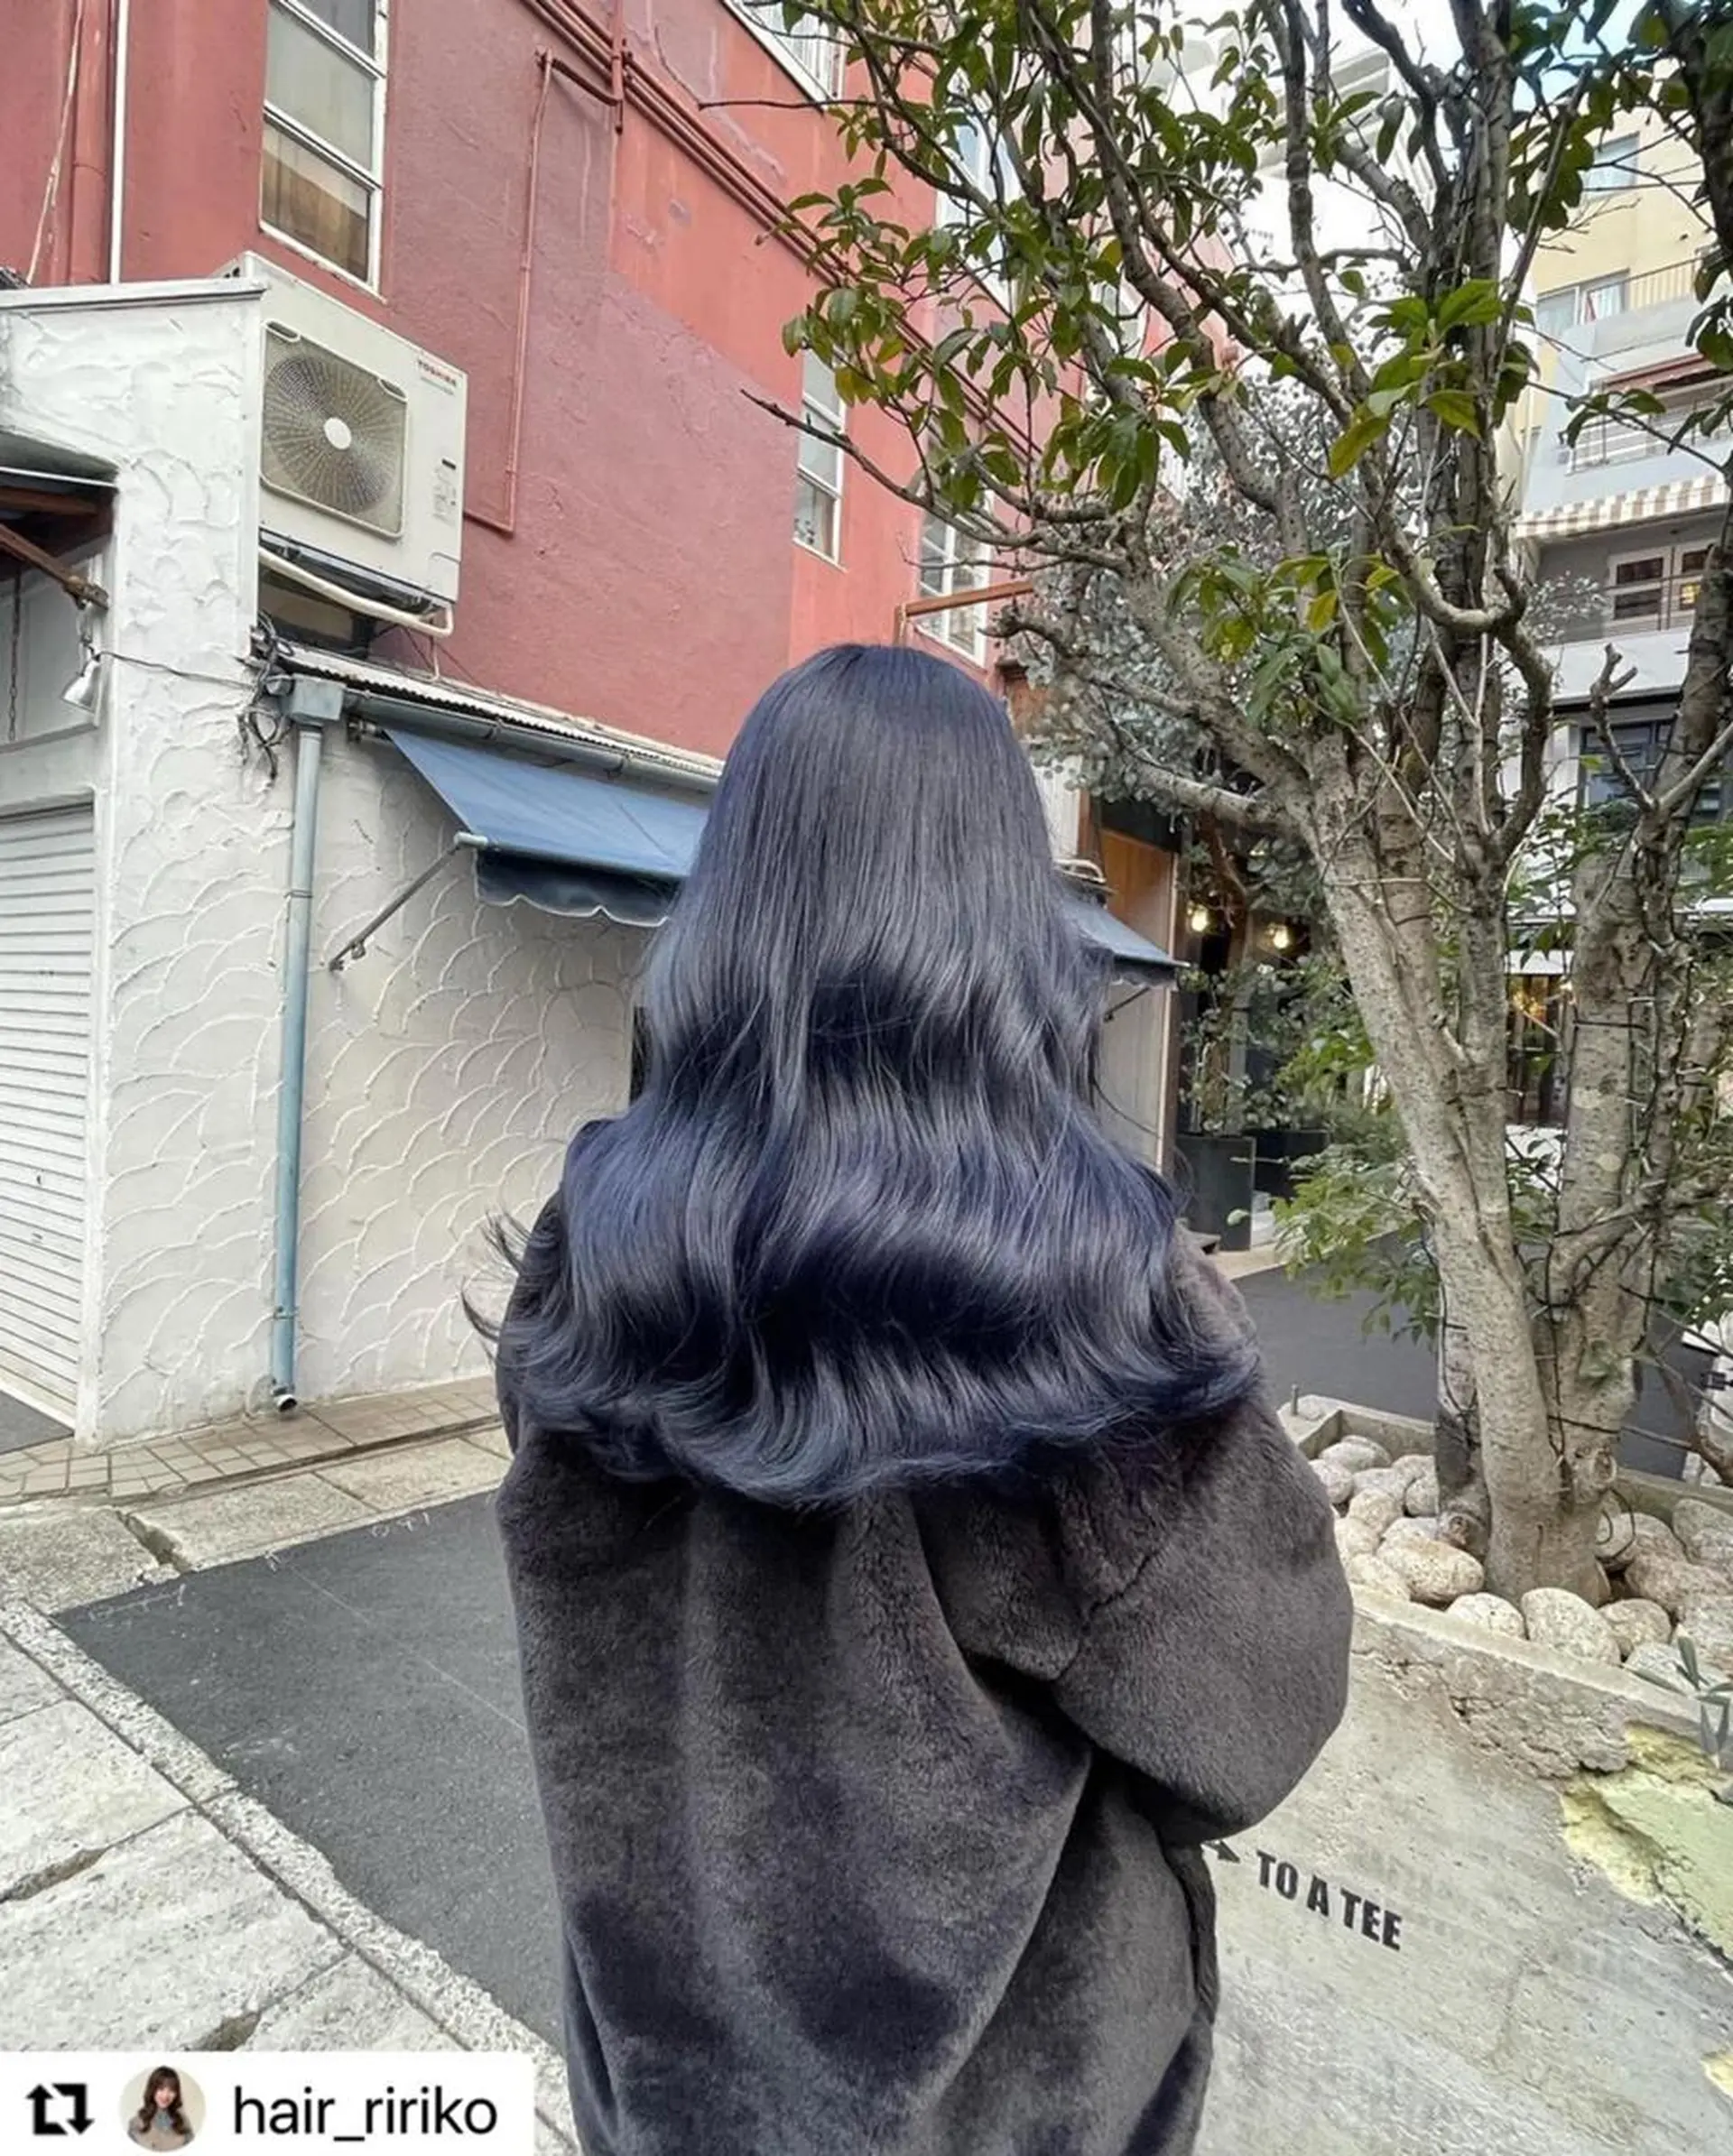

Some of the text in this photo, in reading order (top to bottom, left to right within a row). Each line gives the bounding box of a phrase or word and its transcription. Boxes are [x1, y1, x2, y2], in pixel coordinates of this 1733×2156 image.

[1256, 1850, 1402, 1951] TO A TEE
